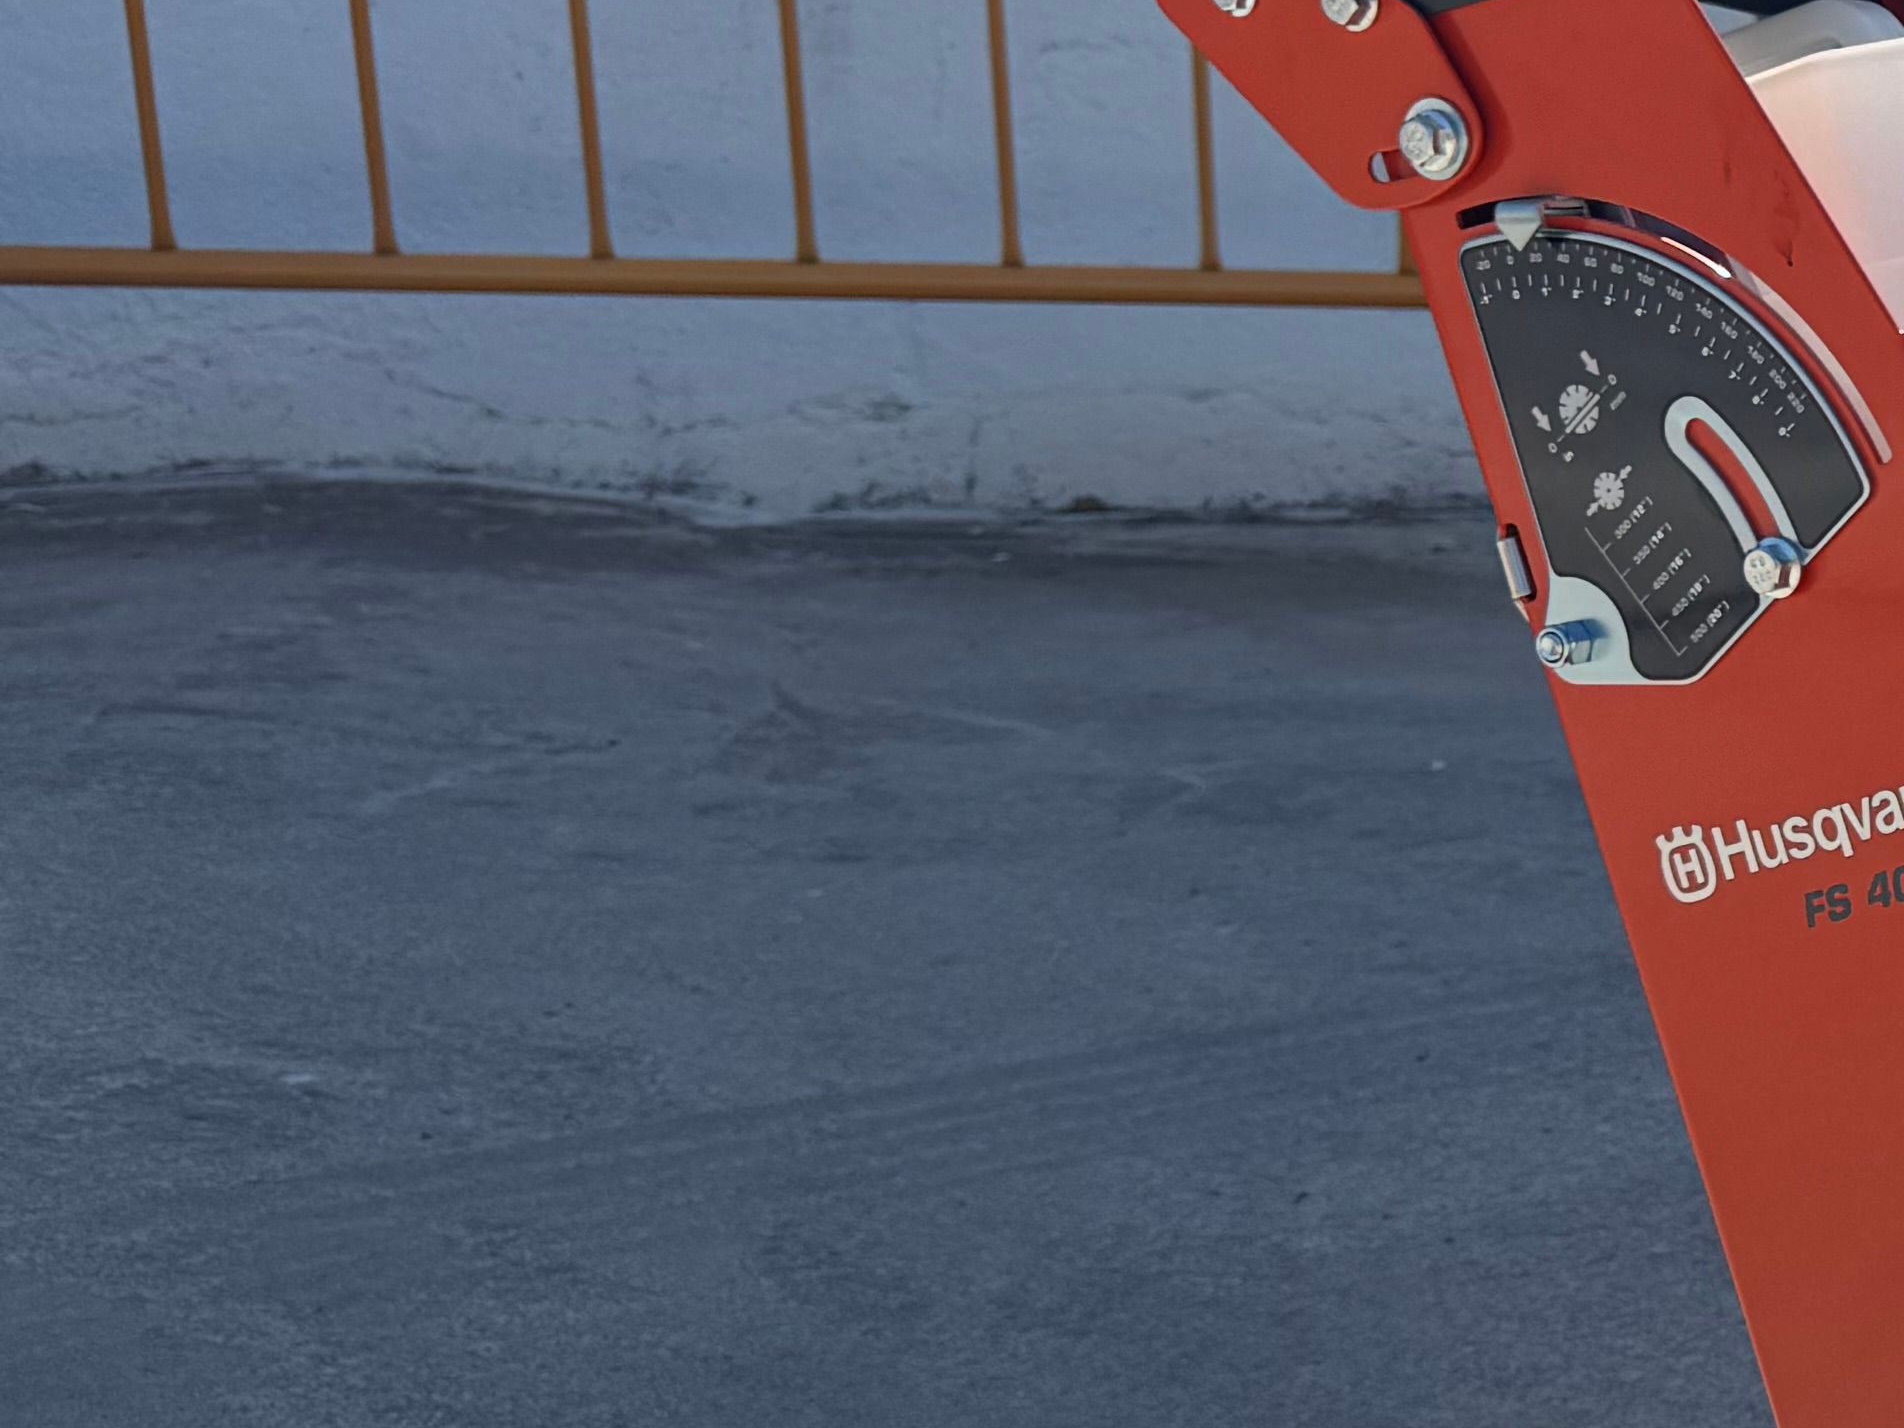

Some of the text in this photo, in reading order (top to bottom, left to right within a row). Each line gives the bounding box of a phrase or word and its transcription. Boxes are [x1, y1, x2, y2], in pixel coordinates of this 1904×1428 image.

[1665, 285, 1685, 301] 120
[1787, 391, 1805, 414] 220
[1804, 883, 1852, 929] FS
